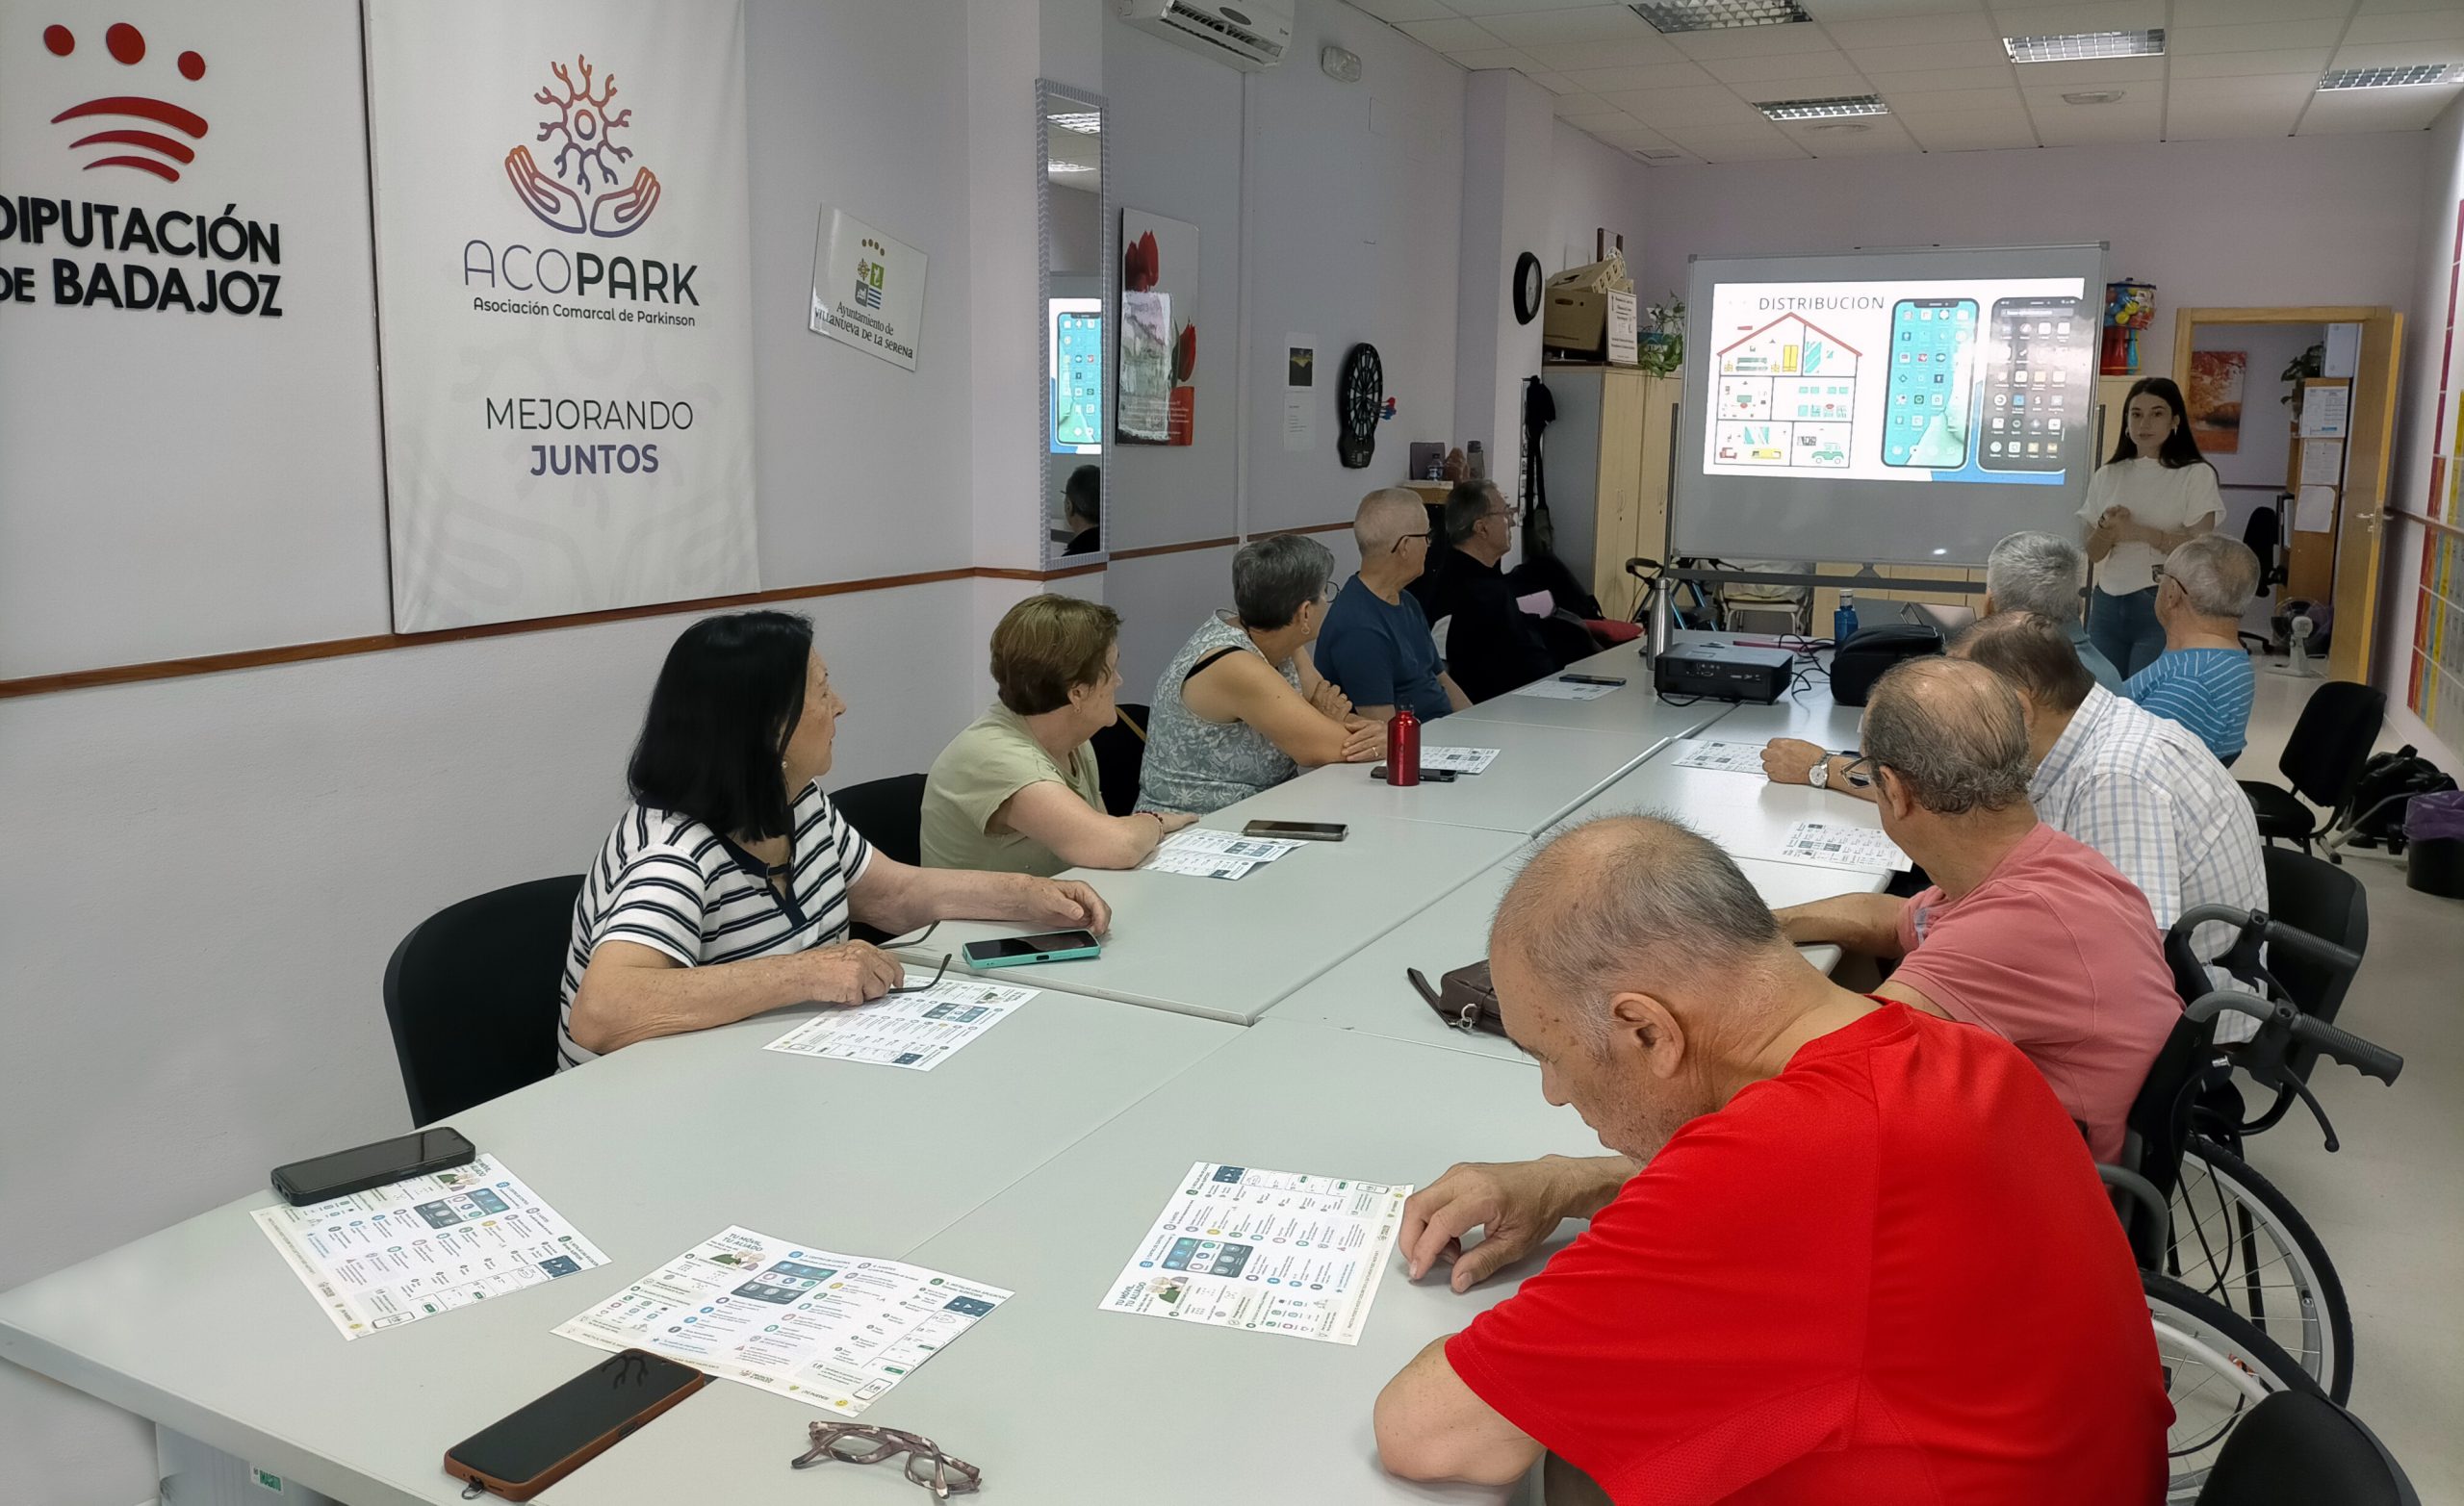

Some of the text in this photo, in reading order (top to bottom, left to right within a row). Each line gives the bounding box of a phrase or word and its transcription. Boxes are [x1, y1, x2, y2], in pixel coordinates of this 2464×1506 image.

[53, 258, 283, 317] BADAJOZ
[464, 240, 700, 306] ACOPARK
[474, 296, 695, 326] Asociación Comarcal de Parkinson
[836, 301, 894, 336] Ayuntamiento de
[1758, 296, 1885, 310] DISTRIBUCION
[486, 397, 693, 430] MEJORANDO
[530, 444, 658, 475] JUNTOS
